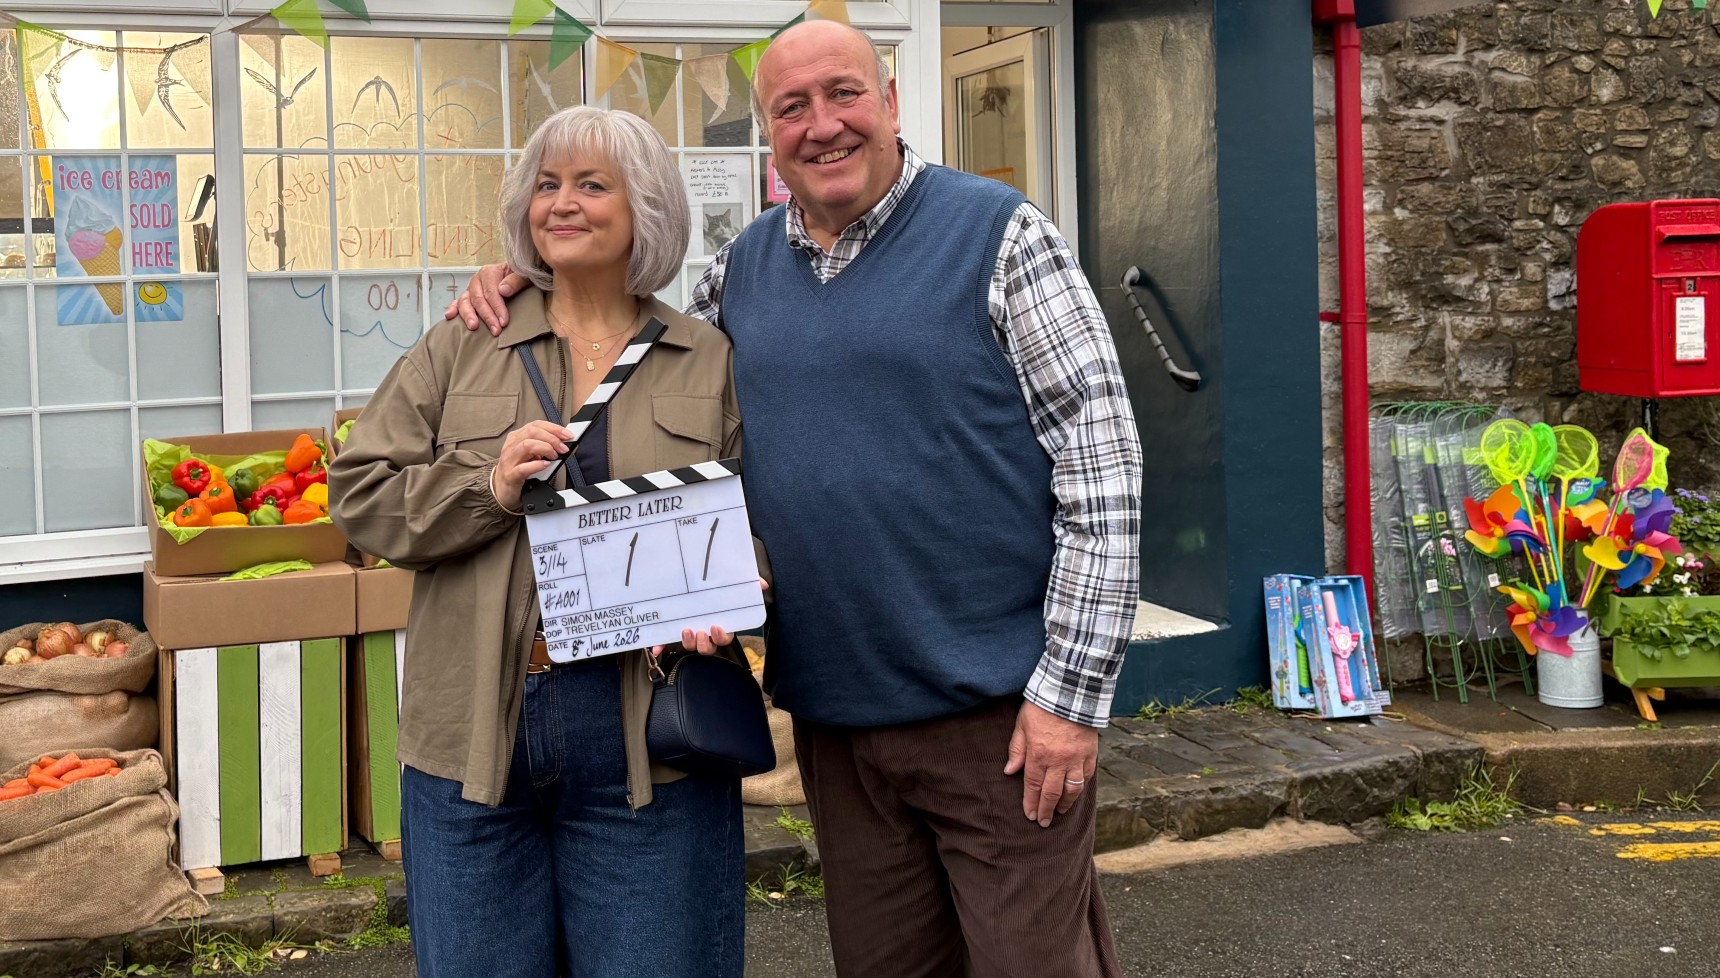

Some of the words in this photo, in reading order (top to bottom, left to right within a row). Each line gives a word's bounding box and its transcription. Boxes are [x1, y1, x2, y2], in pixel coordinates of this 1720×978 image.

[58, 164, 93, 191] ice
[101, 168, 171, 191] cream
[130, 203, 172, 229] SOLD
[1658, 210, 1681, 220] POST
[1684, 209, 1716, 219] OFFICE
[132, 241, 174, 268] HERE
[578, 505, 632, 529] BETTER
[638, 495, 684, 517] LATER
[677, 516, 698, 527] TAKE
[532, 543, 559, 555] SCENE
[581, 534, 606, 546] SLATE
[702, 517, 720, 582] 1
[539, 552, 568, 578] 3/14
[624, 531, 639, 587] 1
[538, 581, 558, 591] ROLL
[544, 620, 558, 628] DIR
[561, 613, 592, 627] SIMON
[594, 606, 634, 620] MASSEY
[545, 630, 563, 638] DOP
[565, 619, 621, 635] TREVELYAN
[624, 611, 659, 623] OLIVER
[548, 642, 569, 652] DATE
[586, 636, 610, 657] June
[613, 627, 640, 647] 2026
